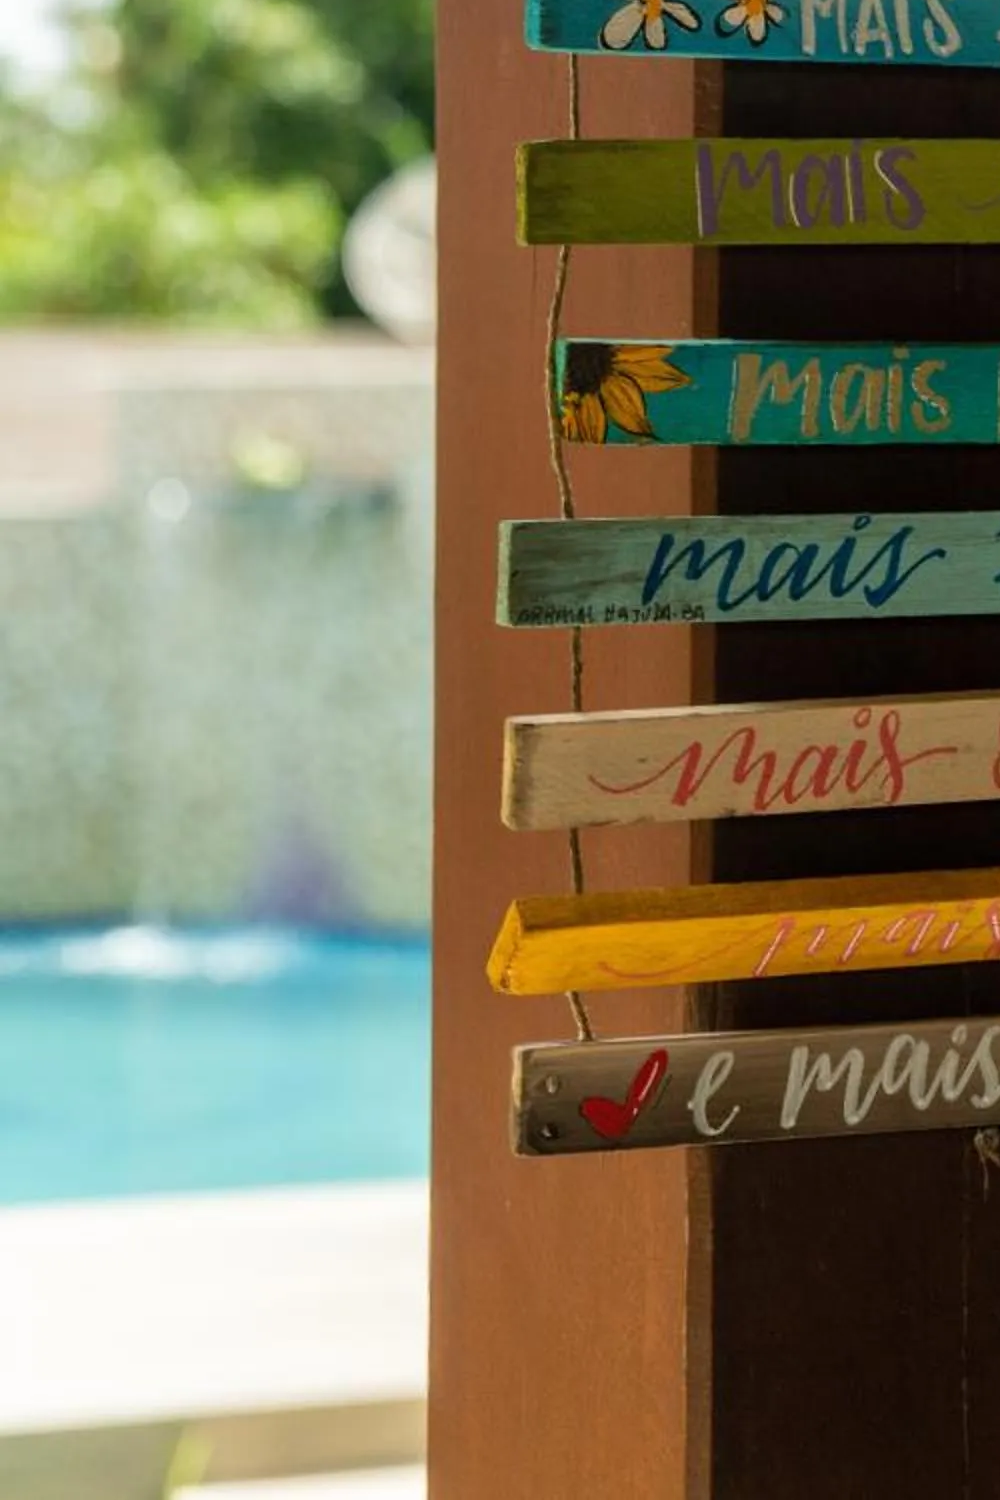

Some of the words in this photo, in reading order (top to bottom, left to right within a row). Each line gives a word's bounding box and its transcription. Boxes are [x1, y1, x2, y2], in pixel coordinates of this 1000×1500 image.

[727, 346, 951, 444] mais
[640, 515, 947, 612] mais
[588, 708, 958, 816] mais
[687, 1050, 741, 1136] e
